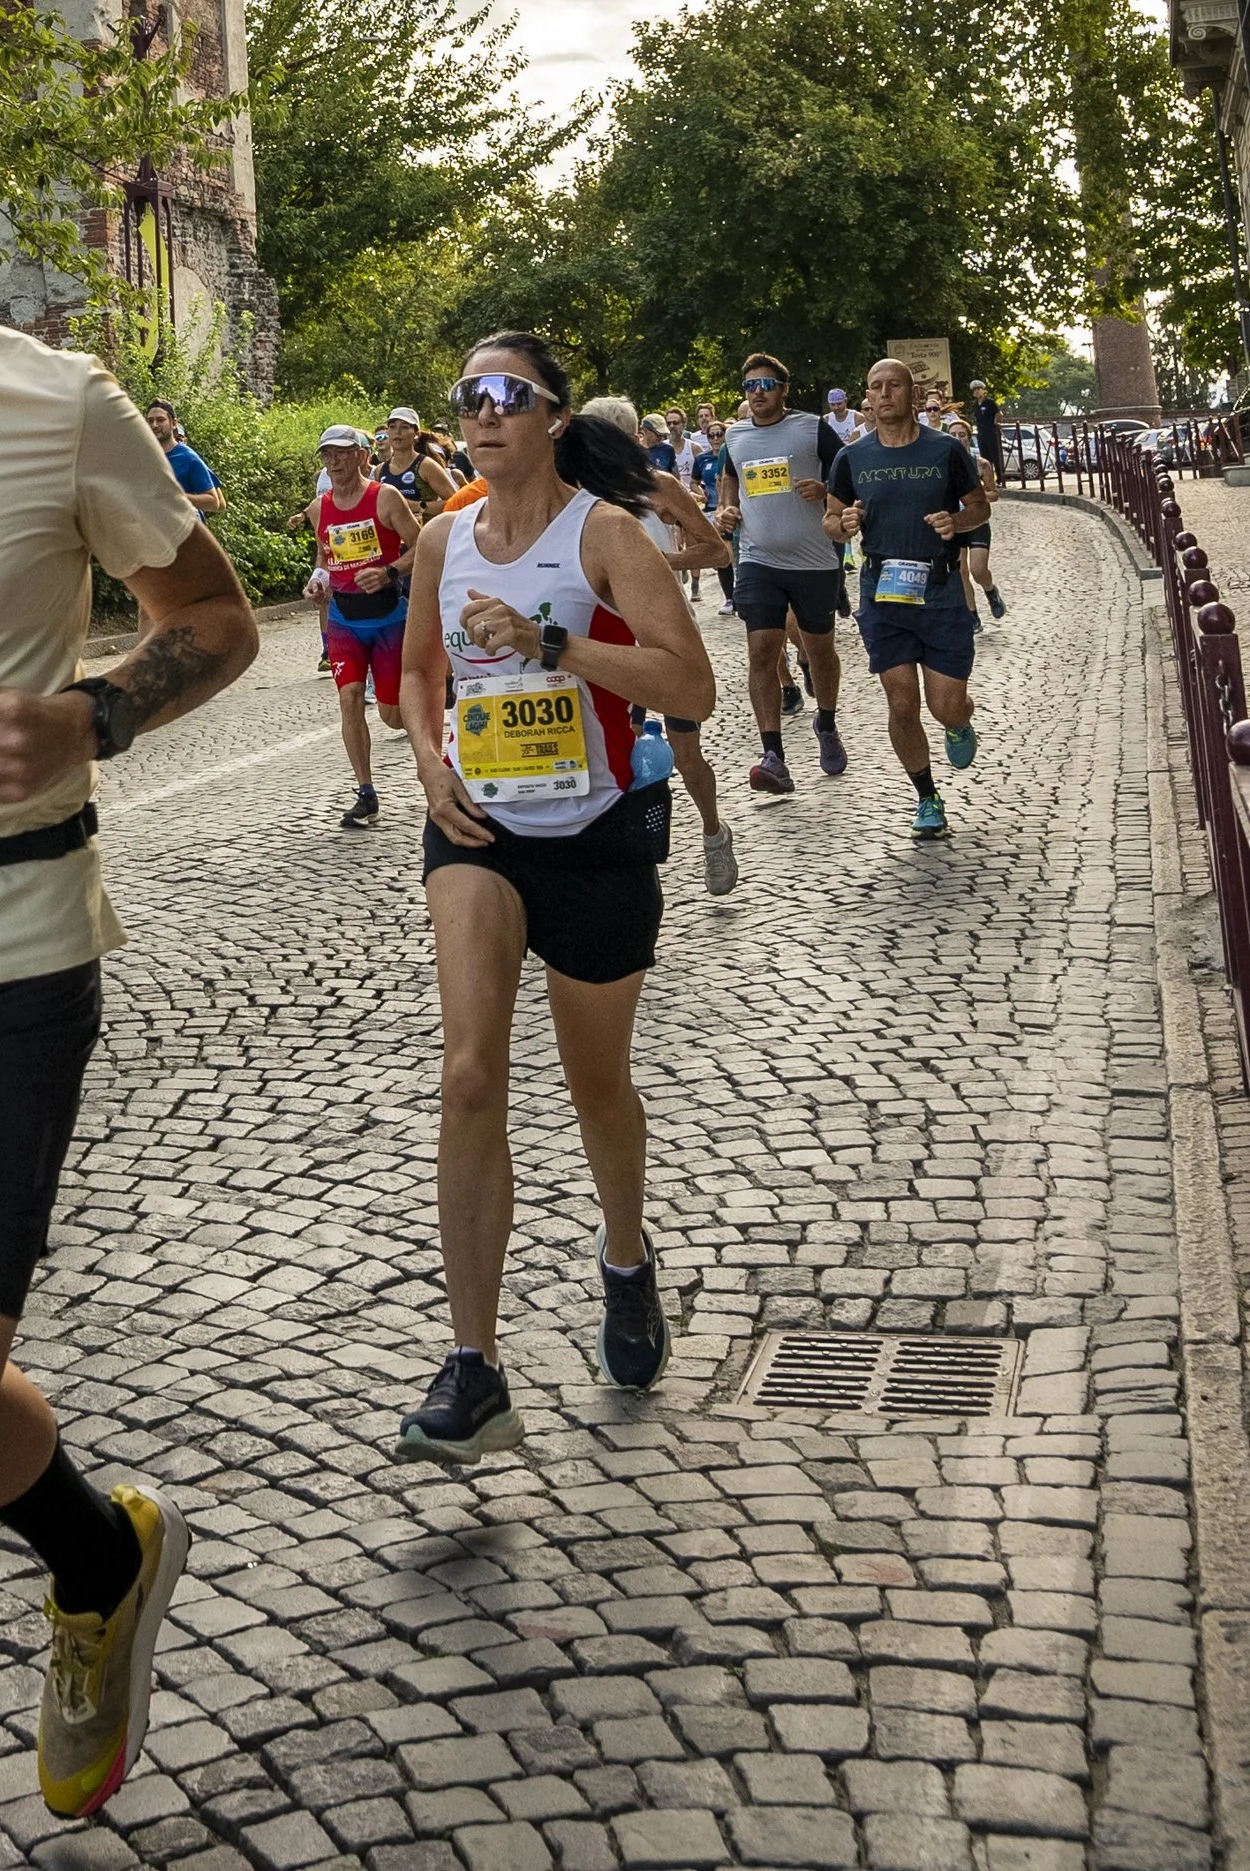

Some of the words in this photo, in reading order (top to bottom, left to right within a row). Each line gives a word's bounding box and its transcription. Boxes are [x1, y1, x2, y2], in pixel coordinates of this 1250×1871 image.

[761, 467, 788, 479] 3352
[858, 466, 942, 484] MONTURA
[350, 527, 375, 543] 3169
[899, 570, 927, 584] 4049
[501, 695, 574, 728] 3030
[504, 728, 545, 739] DEBORAH
[547, 725, 576, 735] RICCA
[553, 779, 577, 790] 3030
